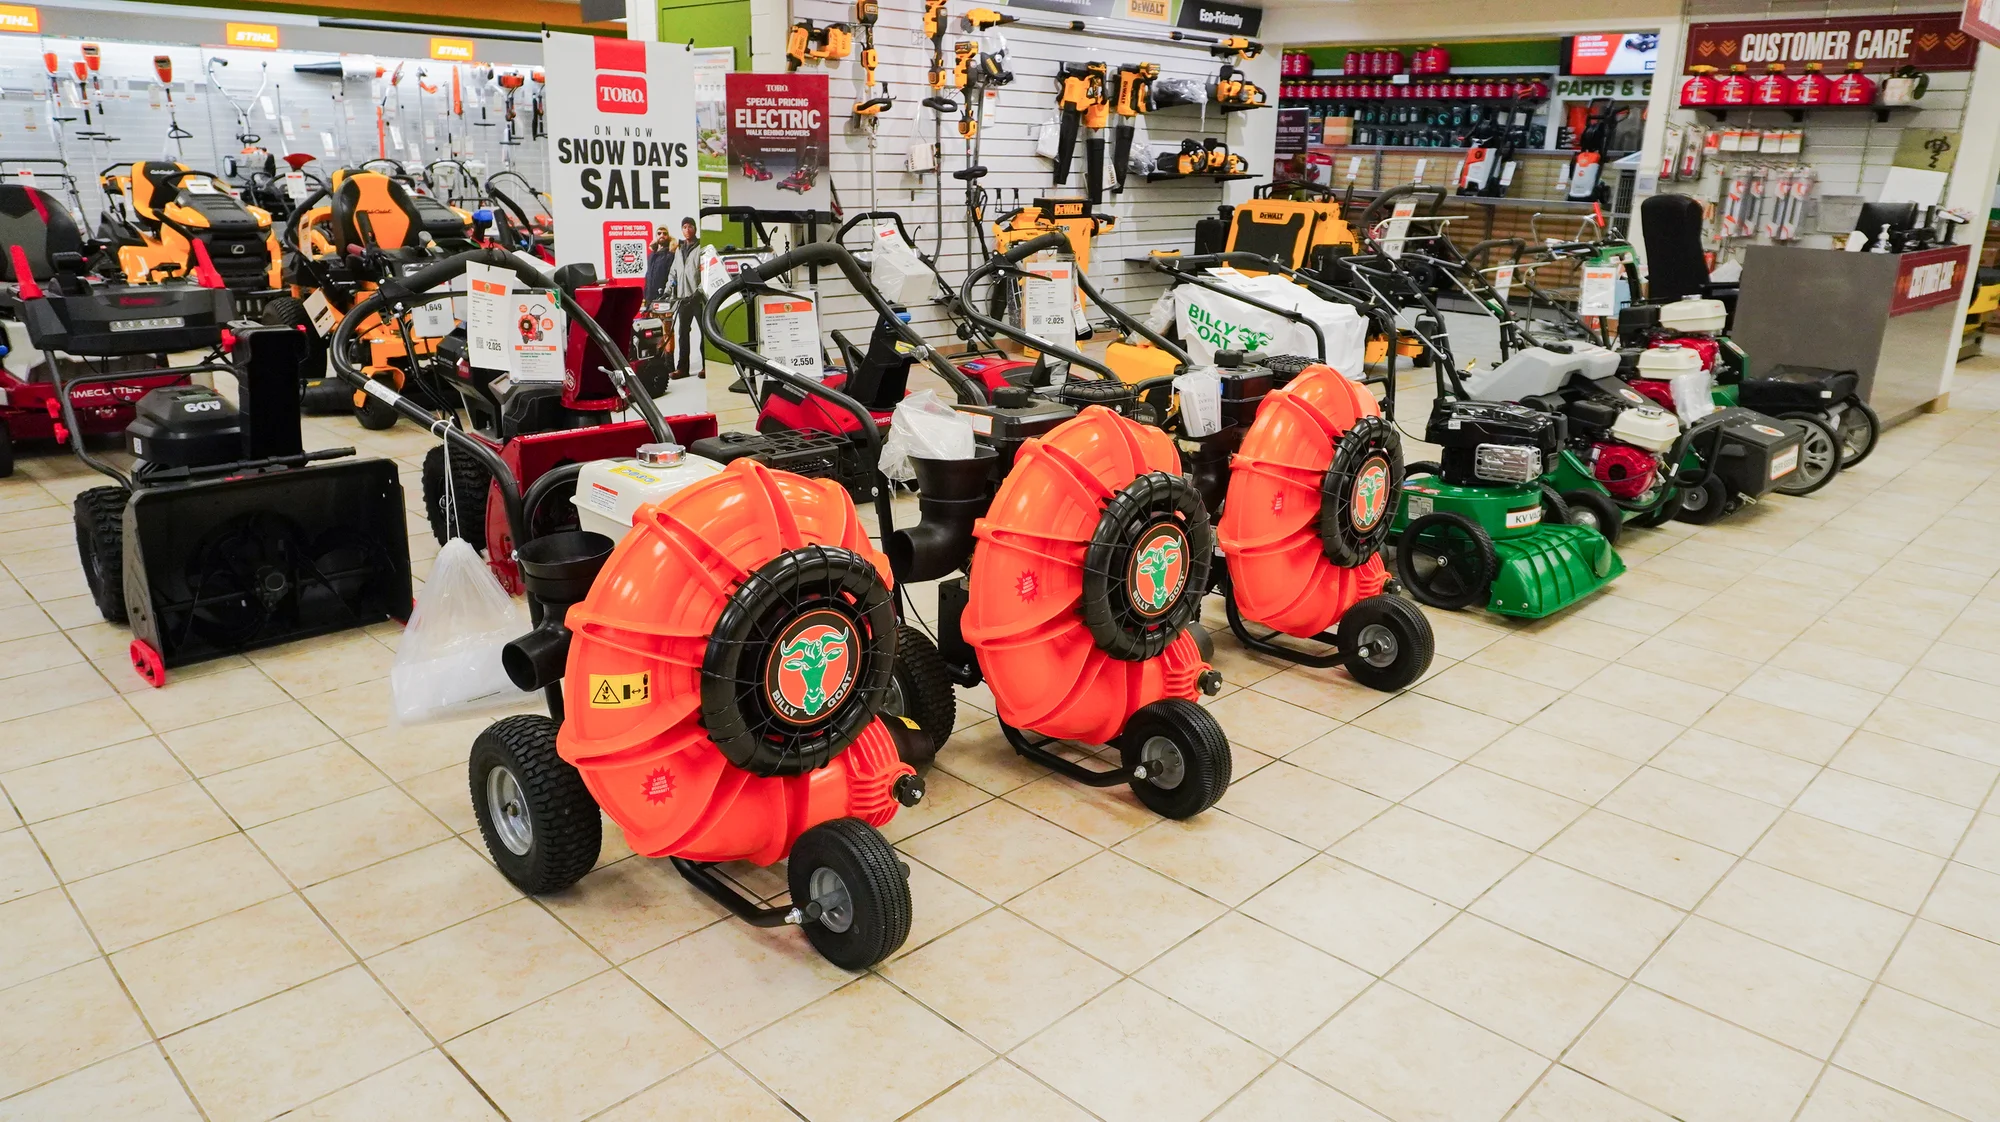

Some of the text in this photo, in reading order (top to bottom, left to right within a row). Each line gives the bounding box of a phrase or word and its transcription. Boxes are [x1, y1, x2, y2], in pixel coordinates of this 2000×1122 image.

[1131, 3, 1165, 16] DEWALT
[0, 14, 33, 26] TIHL
[1199, 8, 1244, 29] Eco-Friendly
[235, 31, 275, 43] STIHL
[437, 45, 470, 57] STIHL
[1740, 28, 1914, 62] CUSTOMER CARE
[600, 86, 645, 103] TORO
[765, 84, 789, 92] TORO
[1556, 80, 1616, 96] PARTS
[1621, 80, 1634, 96] &
[746, 97, 809, 107] SPECIAL PRICING
[735, 108, 821, 130] ELECTRIC
[594, 125, 652, 138] ON NOW
[763, 129, 784, 137] BEHIND
[558, 137, 688, 168] SNOW DAYS
[580, 168, 671, 210] SALE
[1055, 204, 1083, 214] DEWALT
[1259, 212, 1284, 220] DEWALT
[1188, 303, 1237, 336] BILLY
[790, 357, 814, 367] $2,550
[184, 400, 221, 413] 60V
[874, 416, 891, 424] OWER
[1515, 514, 1528, 524] KV
[1132, 573, 1185, 611] BILLY GOAT
[772, 672, 852, 717] BILLY GOAT
